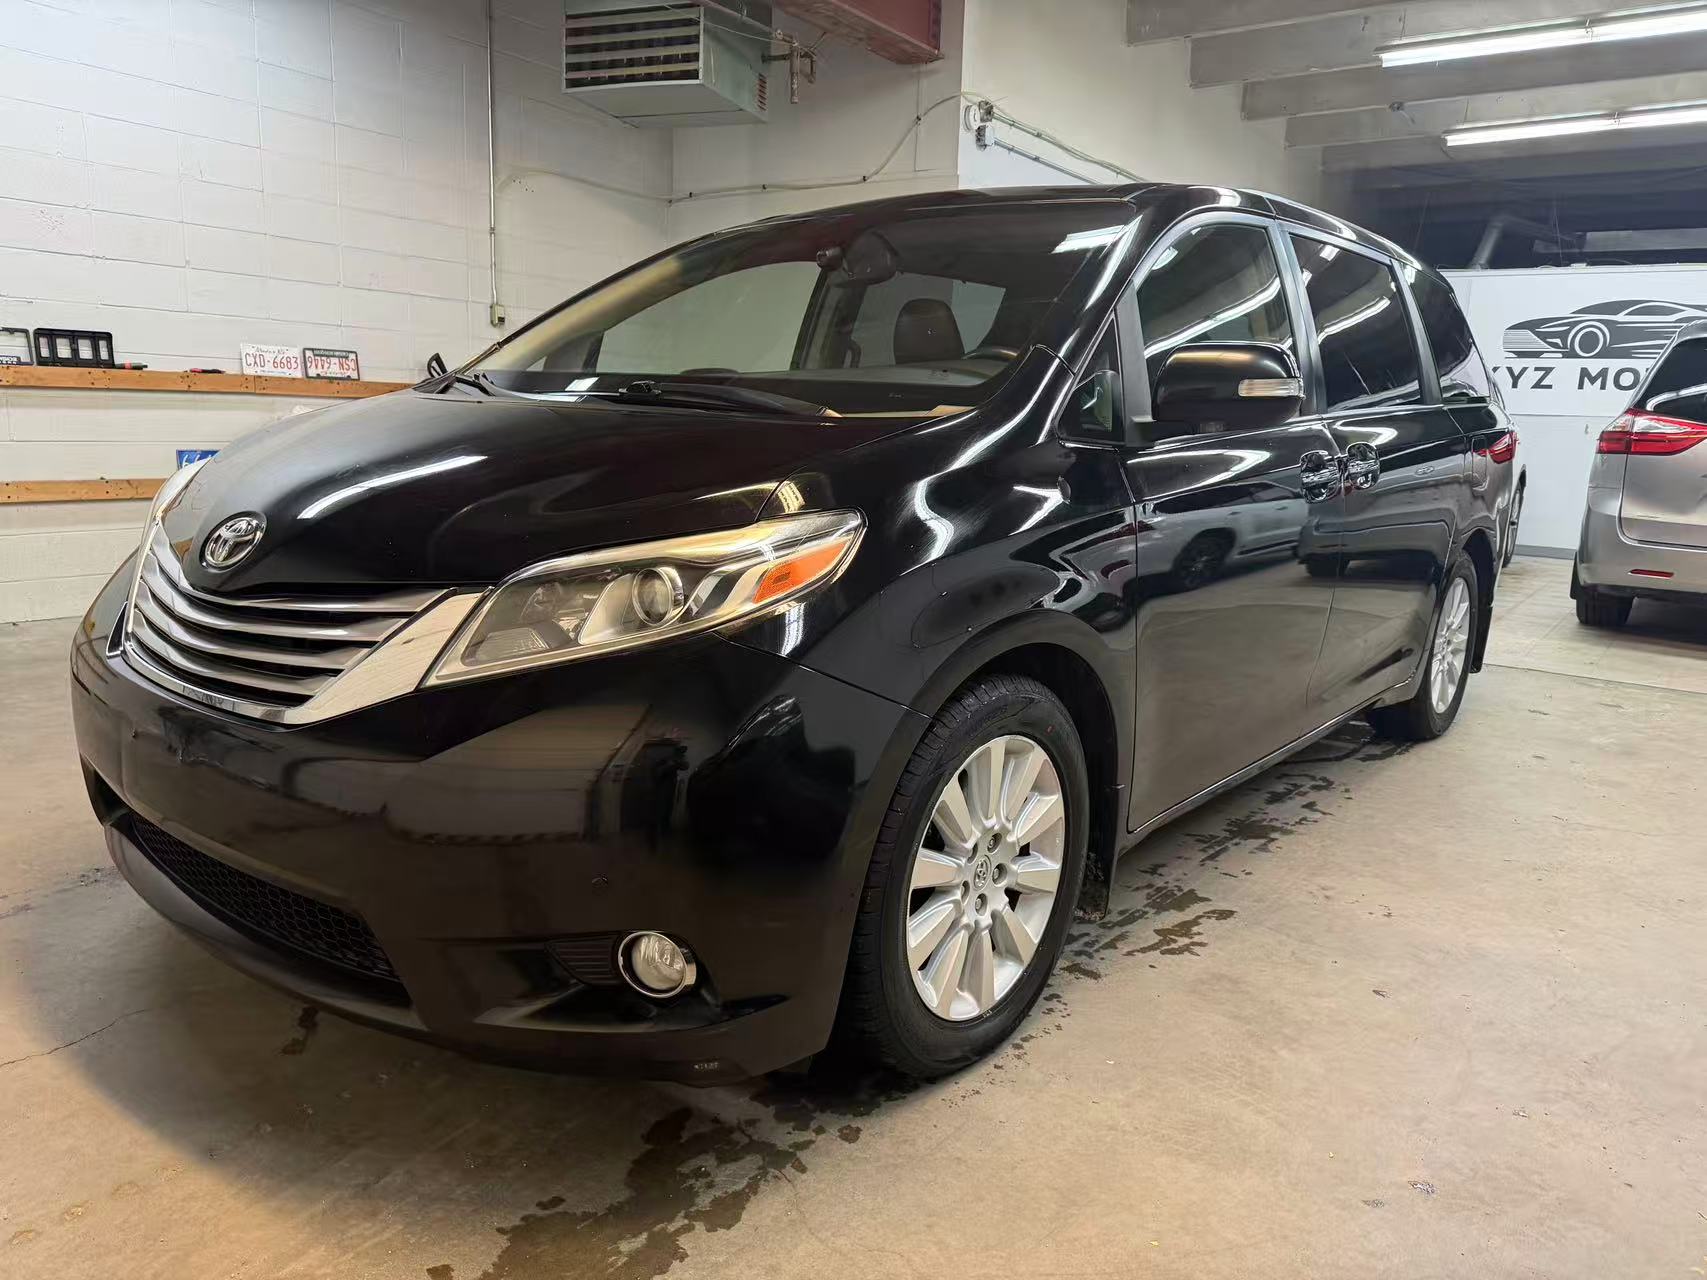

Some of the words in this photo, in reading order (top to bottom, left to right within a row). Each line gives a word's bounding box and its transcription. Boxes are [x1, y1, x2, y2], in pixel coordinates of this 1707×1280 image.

[244, 352, 299, 370] CXD-6683
[1491, 366, 1556, 390] YZ
[1577, 366, 1650, 391] MO
